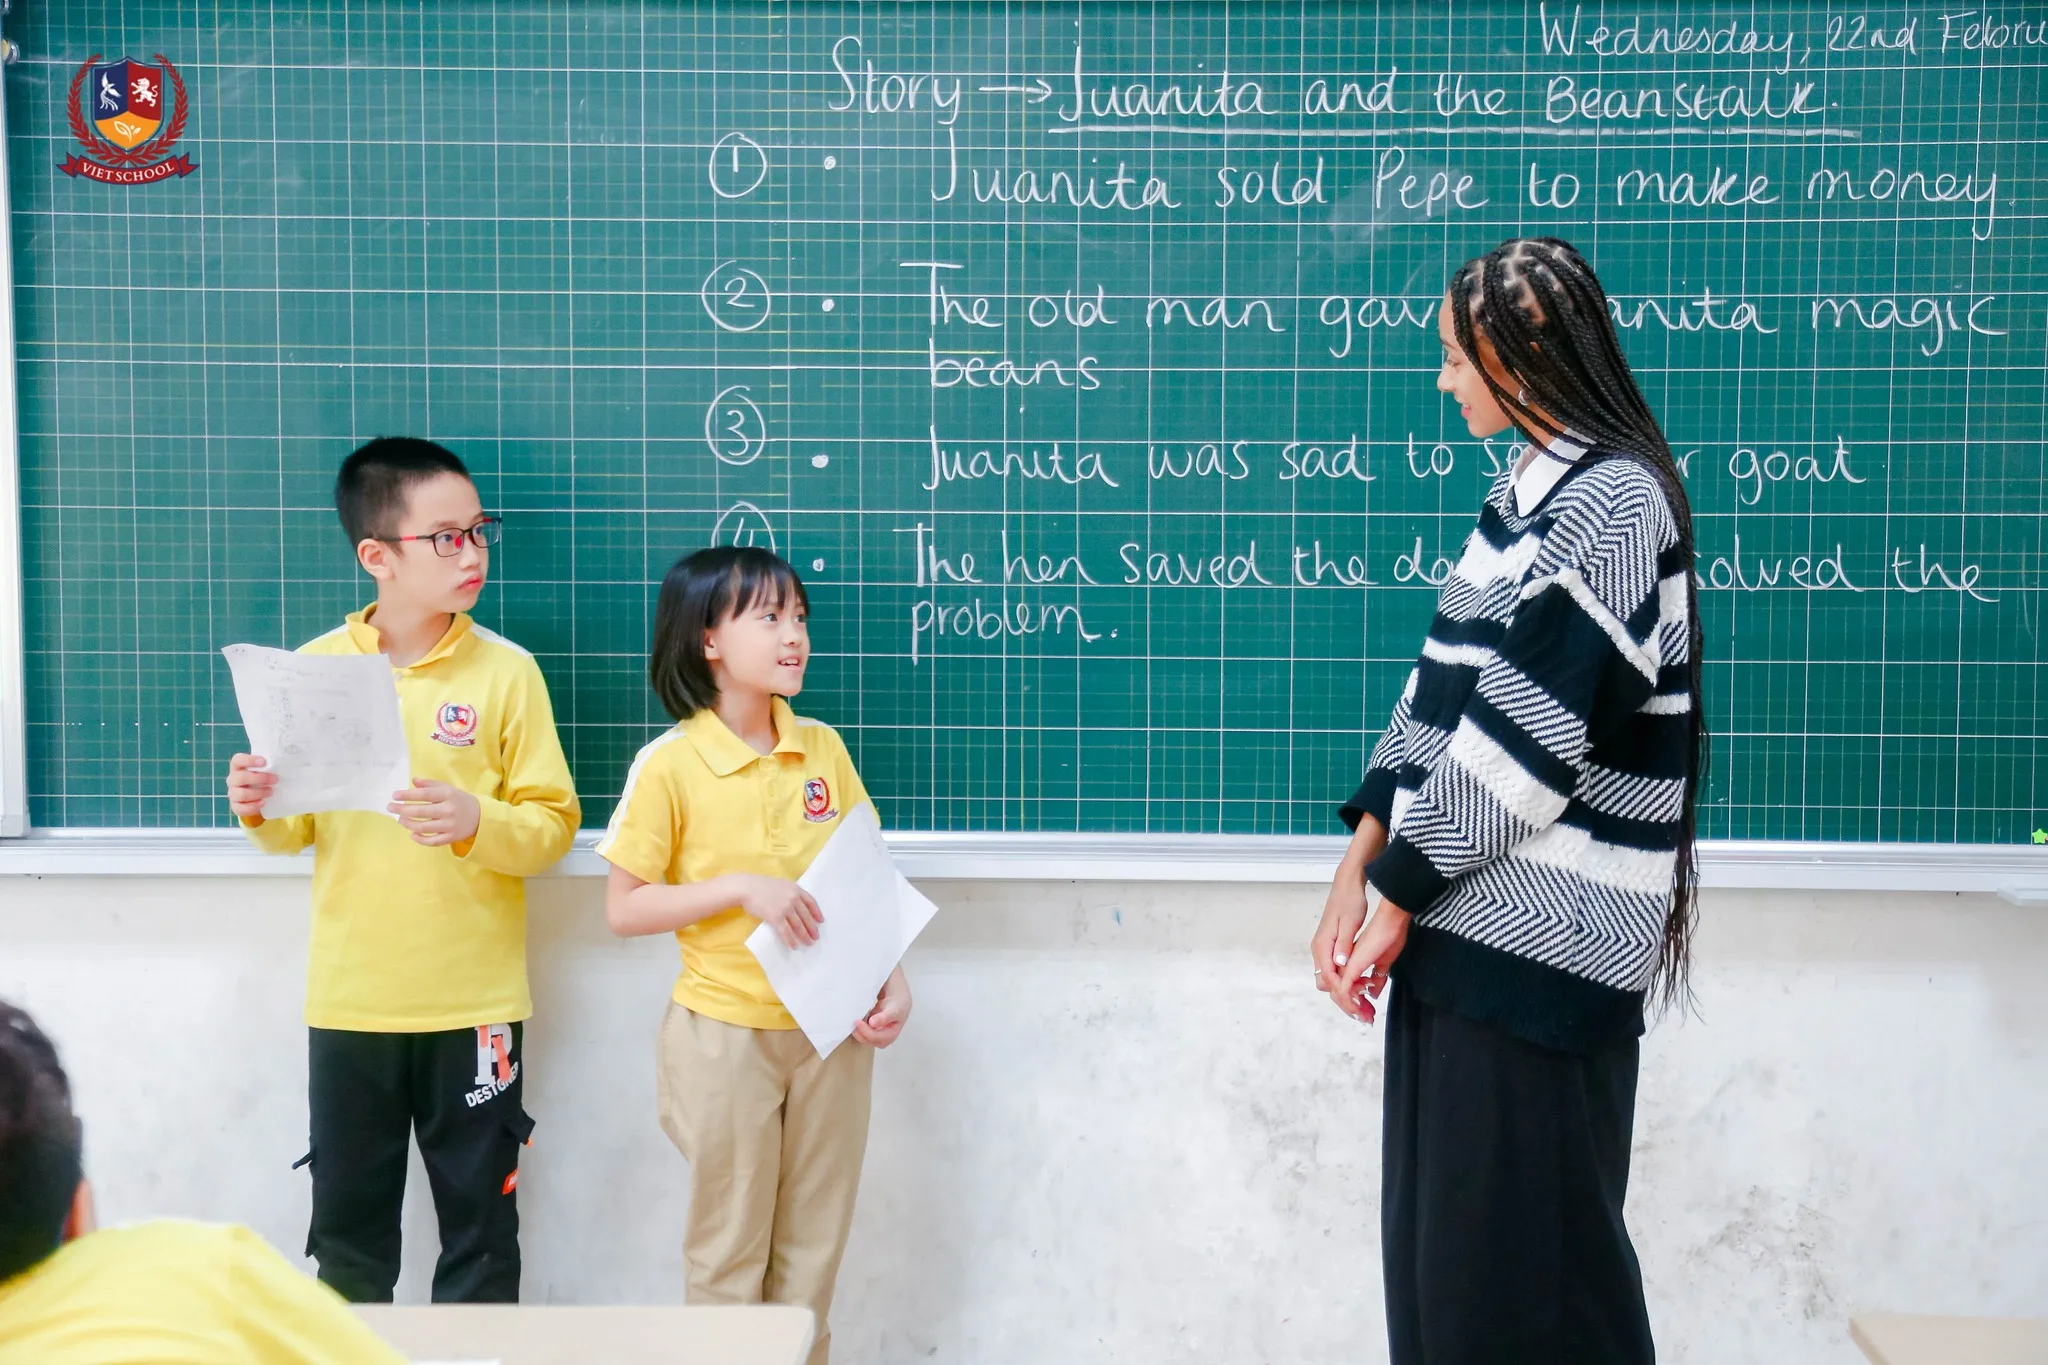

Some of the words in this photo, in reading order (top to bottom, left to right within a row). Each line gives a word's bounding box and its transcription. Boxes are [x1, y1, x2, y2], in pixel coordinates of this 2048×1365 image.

[828, 35, 961, 125] Story
[1058, 44, 1280, 122] Juanita
[1304, 65, 1411, 115] and
[1433, 73, 1513, 117] the
[1539, 1, 1811, 75] Wednesday,
[1828, 15, 1917, 56] 22nd
[930, 127, 1182, 210] Juanita
[1214, 156, 1329, 208] sold
[1375, 145, 1490, 217] Pepe
[1527, 162, 1580, 208] to
[1615, 166, 1780, 207] make
[899, 262, 1004, 328] The
[1028, 283, 1119, 328] old
[1145, 296, 1287, 332] man
[1319, 294, 1435, 359] gav
[1605, 281, 1778, 334] anita
[1811, 284, 2008, 357] magic
[927, 337, 1101, 391] beans
[921, 407, 1119, 491] Juanita
[1148, 440, 1250, 480] was
[1279, 434, 1377, 482] sad
[1405, 431, 1454, 479] to
[1728, 434, 1867, 506] goat
[892, 522, 983, 588] The
[1001, 529, 1100, 585] hen
[1294, 540, 1379, 586] the
[1393, 535, 1456, 586] da
[1692, 533, 1865, 592] olved
[1891, 542, 2001, 603] the
[911, 597, 1118, 667] problem.
